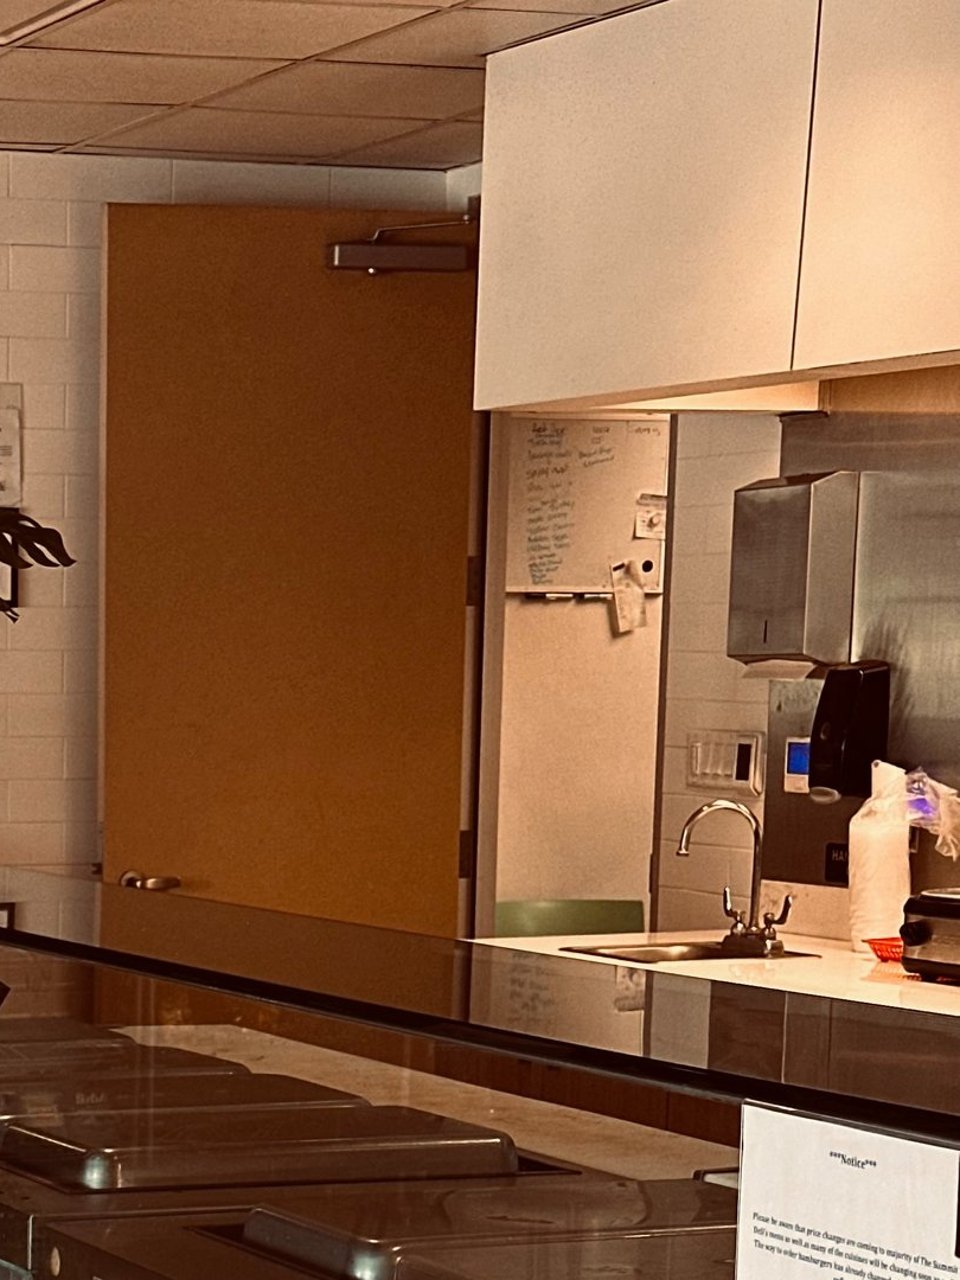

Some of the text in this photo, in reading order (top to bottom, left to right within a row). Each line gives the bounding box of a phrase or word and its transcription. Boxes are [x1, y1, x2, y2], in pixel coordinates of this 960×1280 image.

[753, 1212, 770, 1223] Please
[771, 1217, 777, 1225] be
[794, 1223, 805, 1233] that
[806, 1228, 821, 1238] price
[822, 1232, 845, 1244] changes
[846, 1238, 855, 1247] are
[856, 1242, 878, 1255] coming
[879, 1247, 885, 1255] to
[886, 1249, 912, 1263] majority
[913, 1255, 921, 1263] of
[921, 1256, 931, 1266] The
[933, 1260, 958, 1273] Summit
[754, 1239, 764, 1248] The
[765, 1245, 775, 1255] way
[798, 1252, 833, 1268] hamburgers
[833, 1262, 844, 1271] has
[845, 1265, 866, 1278] already
[769, 1231, 784, 1241] menu
[810, 1243, 826, 1253] many
[827, 1247, 834, 1255] of
[834, 1248, 844, 1257] the
[869, 1259, 879, 1268] will
[881, 1261, 888, 1270] be
[889, 1263, 917, 1279] changing
